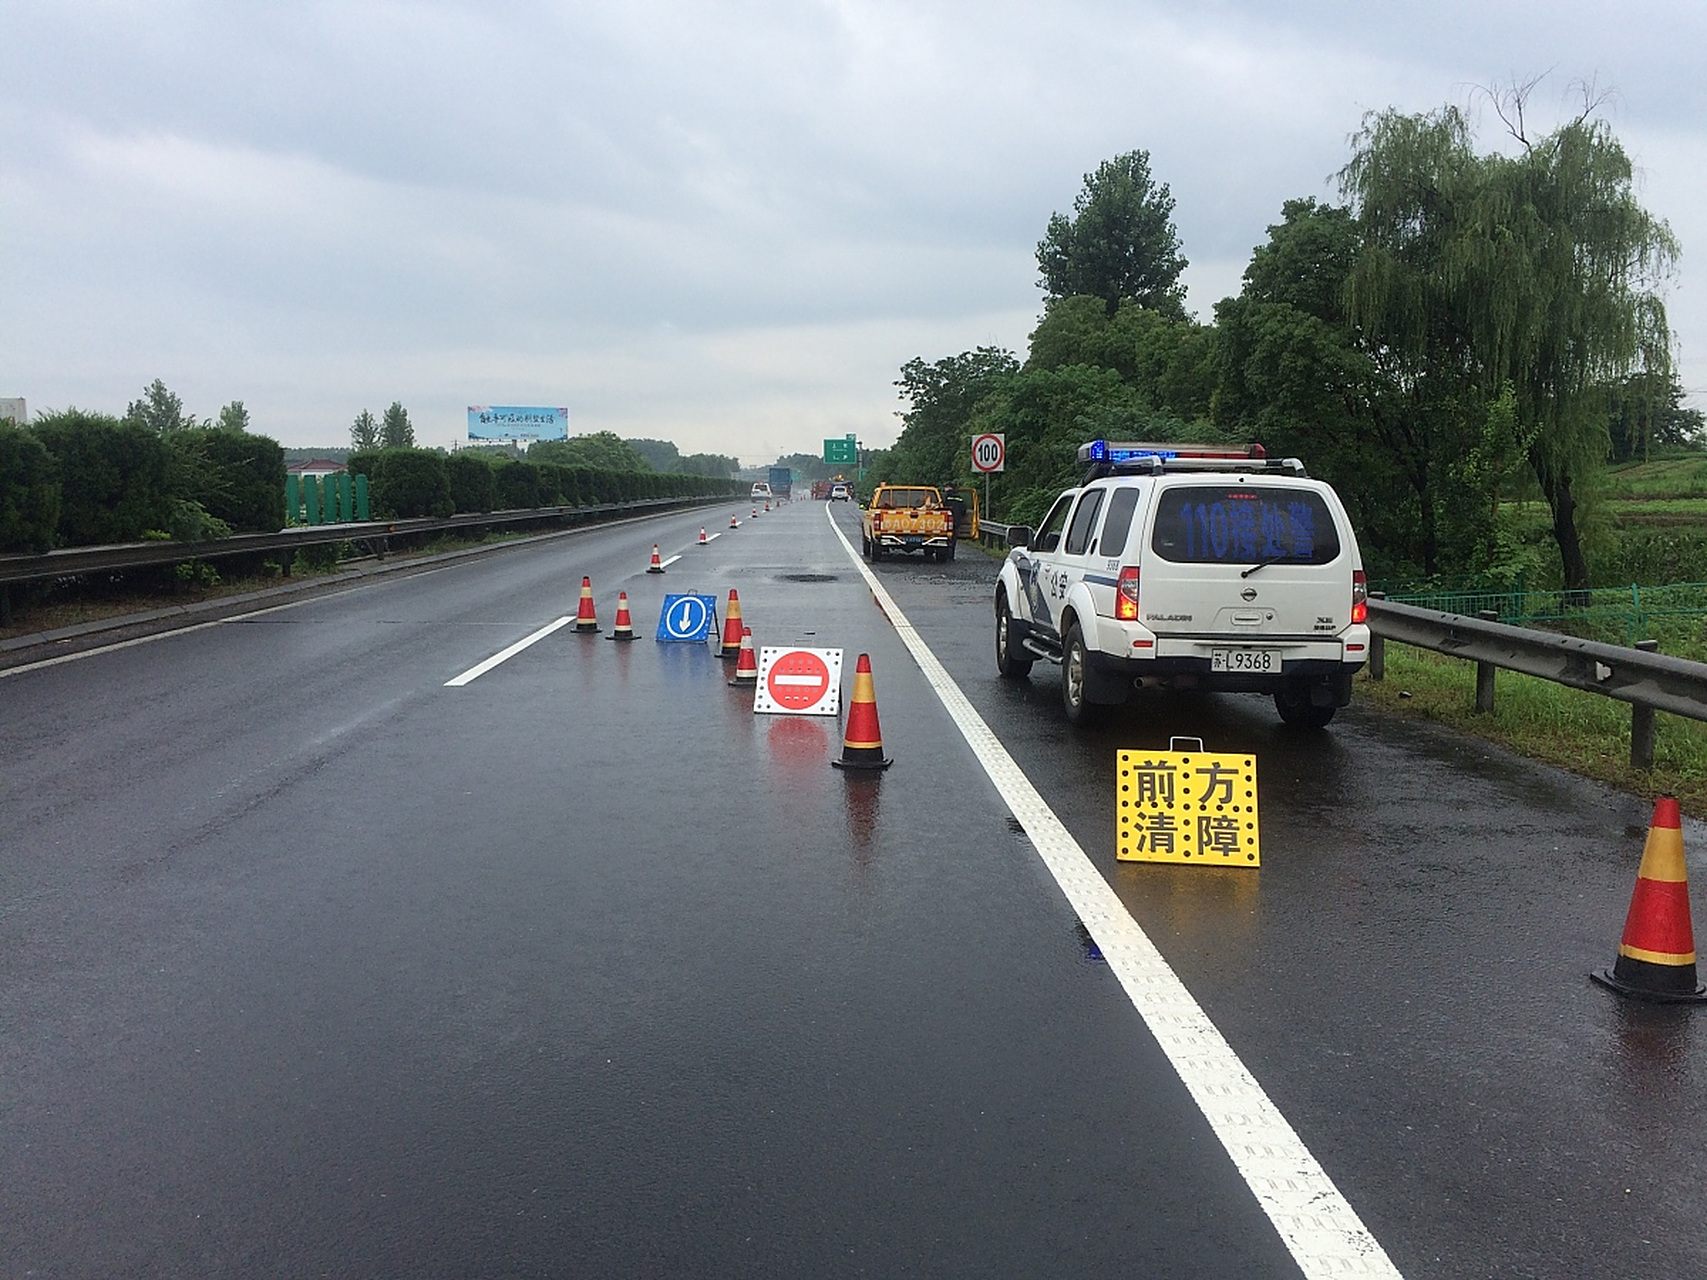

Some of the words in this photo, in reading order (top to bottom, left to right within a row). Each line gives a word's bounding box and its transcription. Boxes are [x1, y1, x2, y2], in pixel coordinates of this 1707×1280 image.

[978, 443, 998, 462] 100
[1180, 501, 1314, 559] 110接处警
[1050, 568, 1068, 600] 公安
[1133, 760, 1239, 804] 前方
[1133, 811, 1241, 857] 清障
